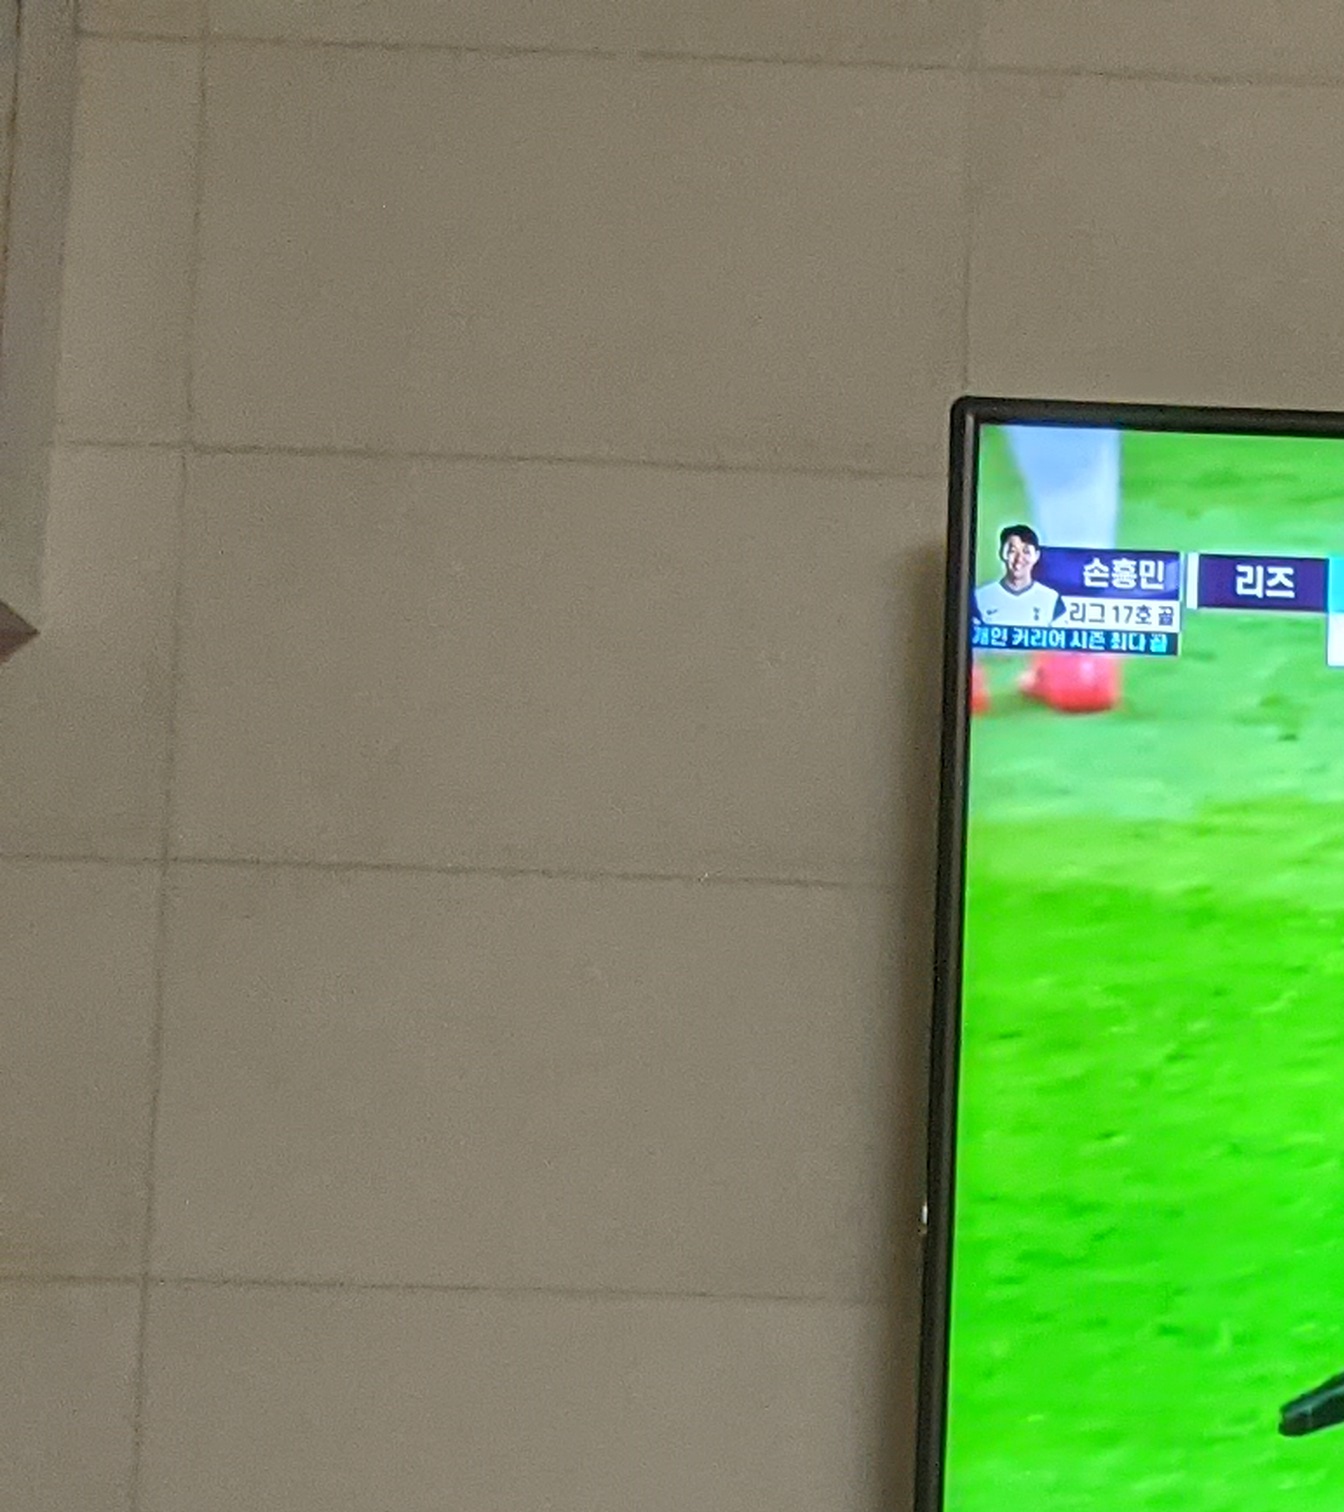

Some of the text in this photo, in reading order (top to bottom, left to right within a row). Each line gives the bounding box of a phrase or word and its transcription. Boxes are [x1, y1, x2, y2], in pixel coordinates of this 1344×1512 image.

[1083, 557, 1164, 590] 손흥민
[1235, 564, 1295, 598] 리즈
[1069, 602, 1105, 624] 리그
[1112, 604, 1152, 625] 17호
[1012, 628, 1066, 648] 커리어
[1070, 630, 1106, 651] 시즌
[1111, 632, 1147, 651] 최다
